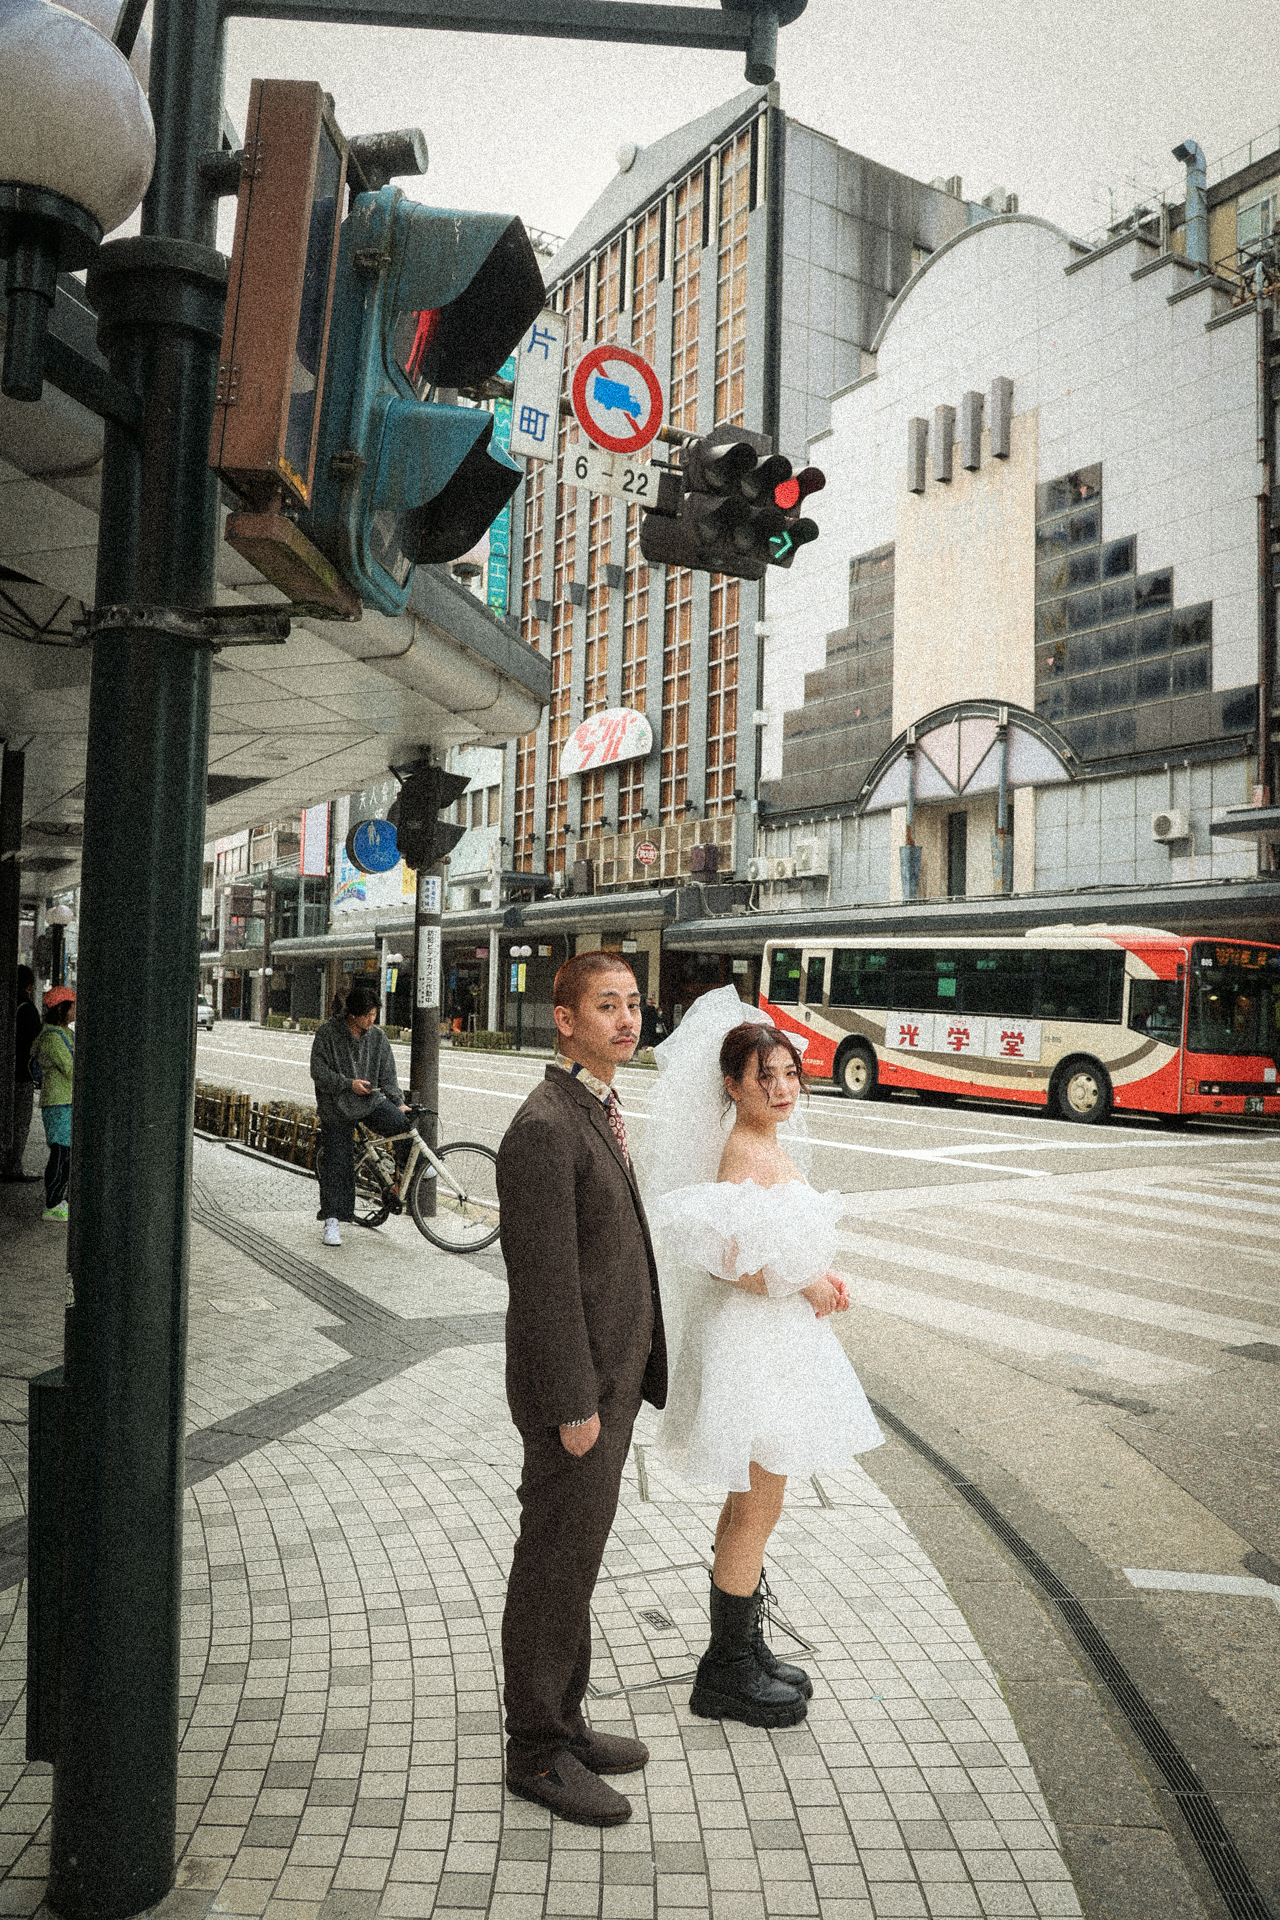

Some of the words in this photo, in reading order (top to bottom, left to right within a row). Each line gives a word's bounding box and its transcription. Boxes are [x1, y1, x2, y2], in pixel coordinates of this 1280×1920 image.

[519, 323, 557, 443] 片町
[898, 1023, 1025, 1058] 光学堂
